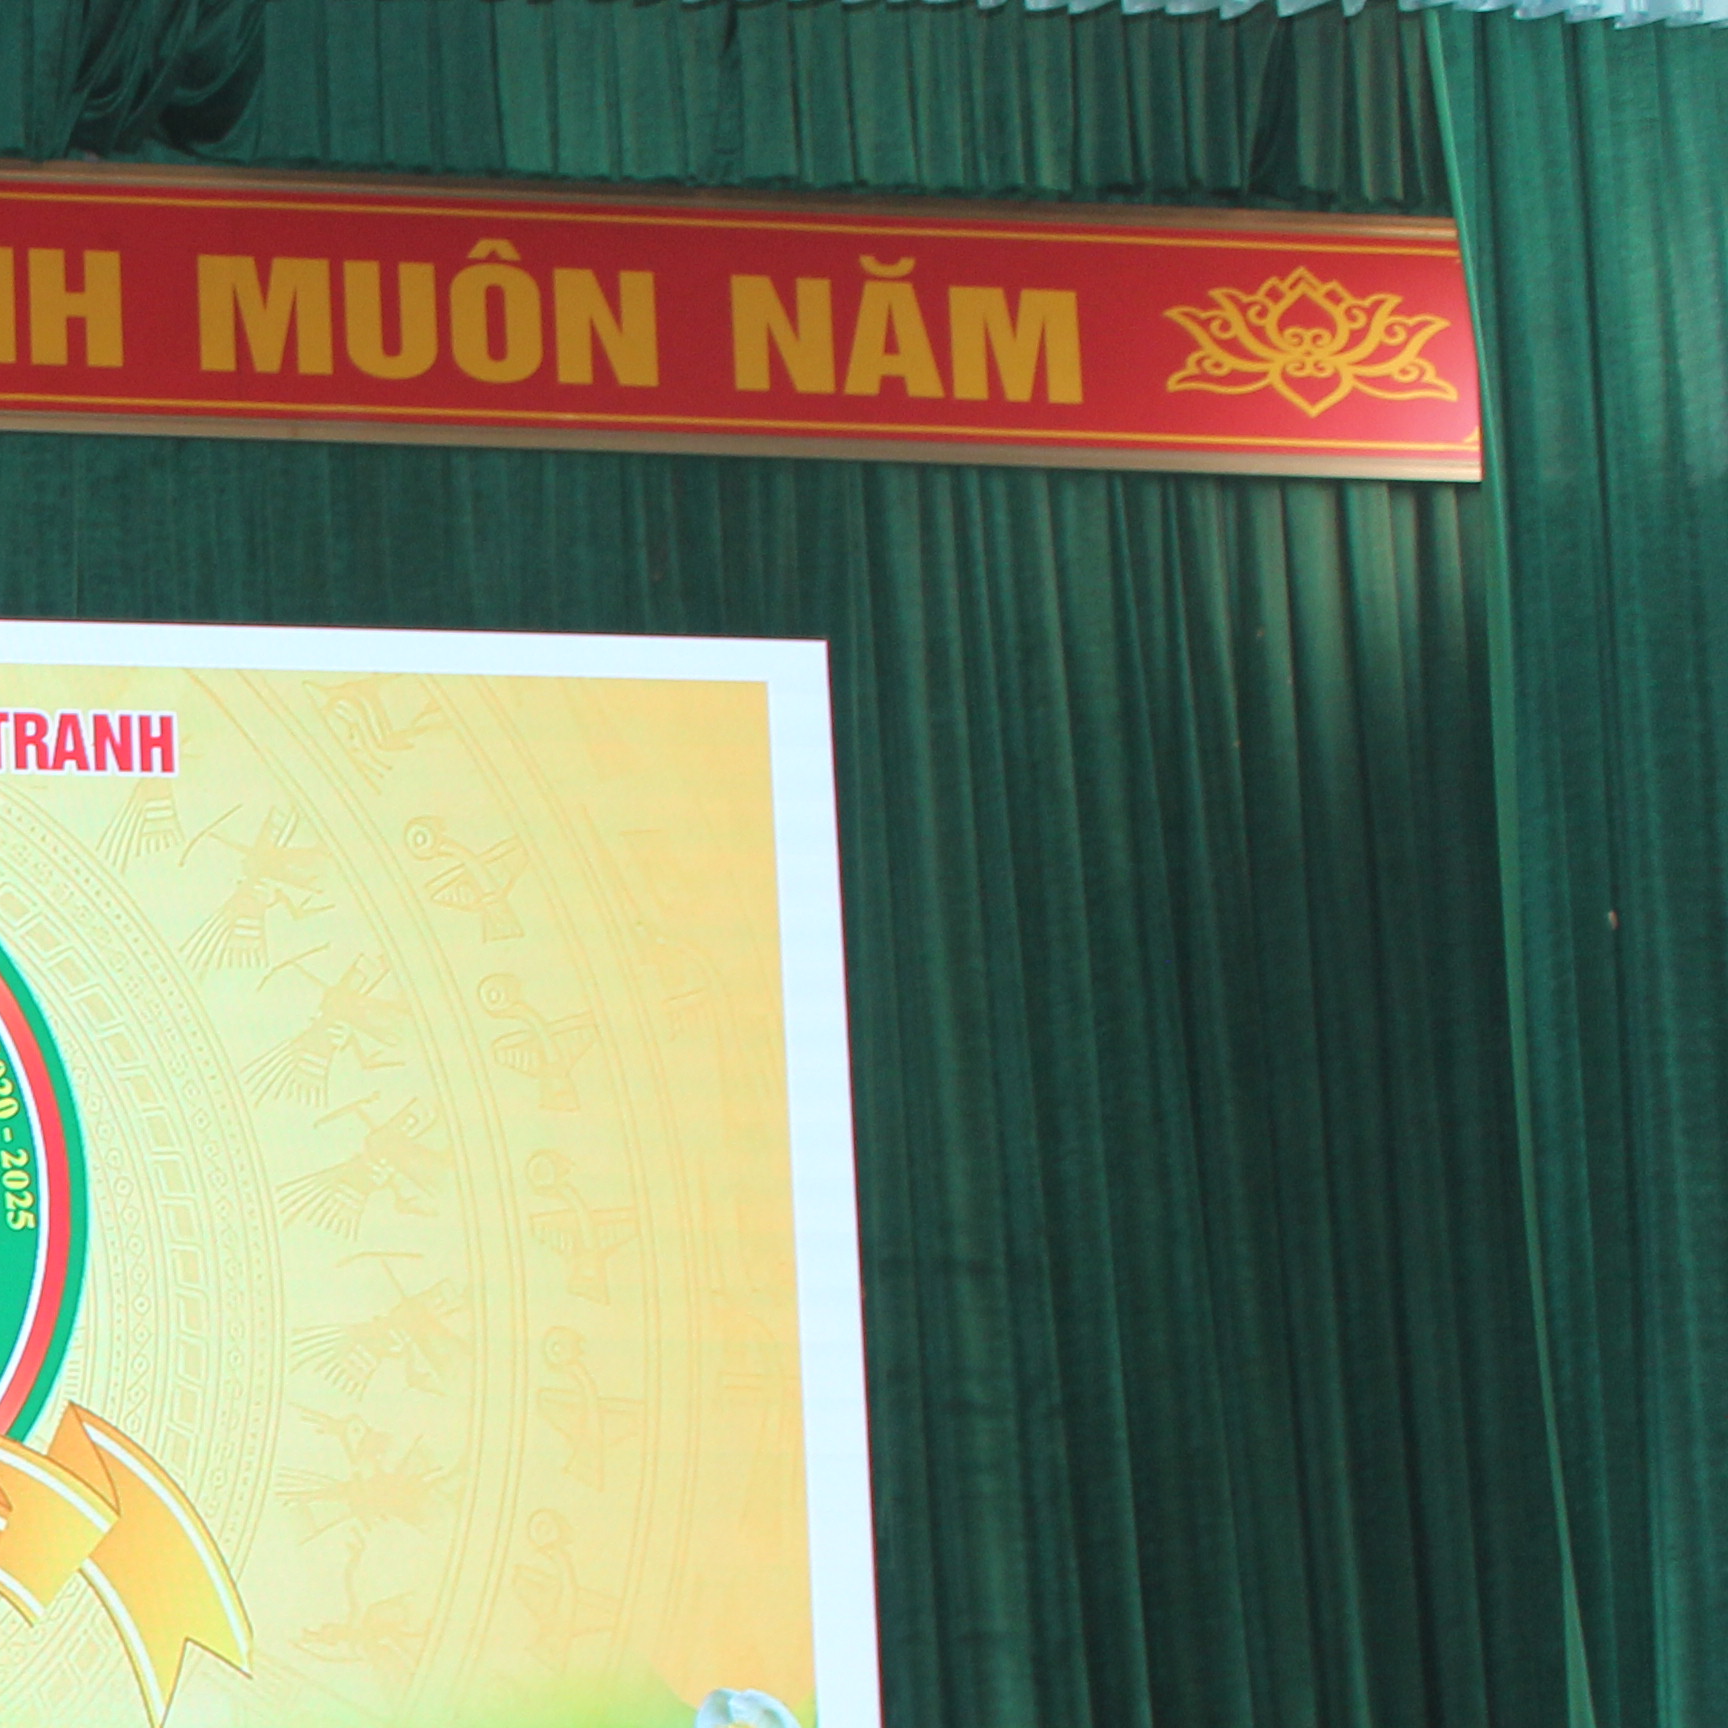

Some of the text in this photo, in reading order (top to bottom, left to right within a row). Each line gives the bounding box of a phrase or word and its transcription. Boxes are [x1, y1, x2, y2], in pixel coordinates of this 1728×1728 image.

[197, 240, 658, 386] MUÔN
[732, 254, 1083, 403] NĂM
[0, 1148, 36, 1232] 2025
